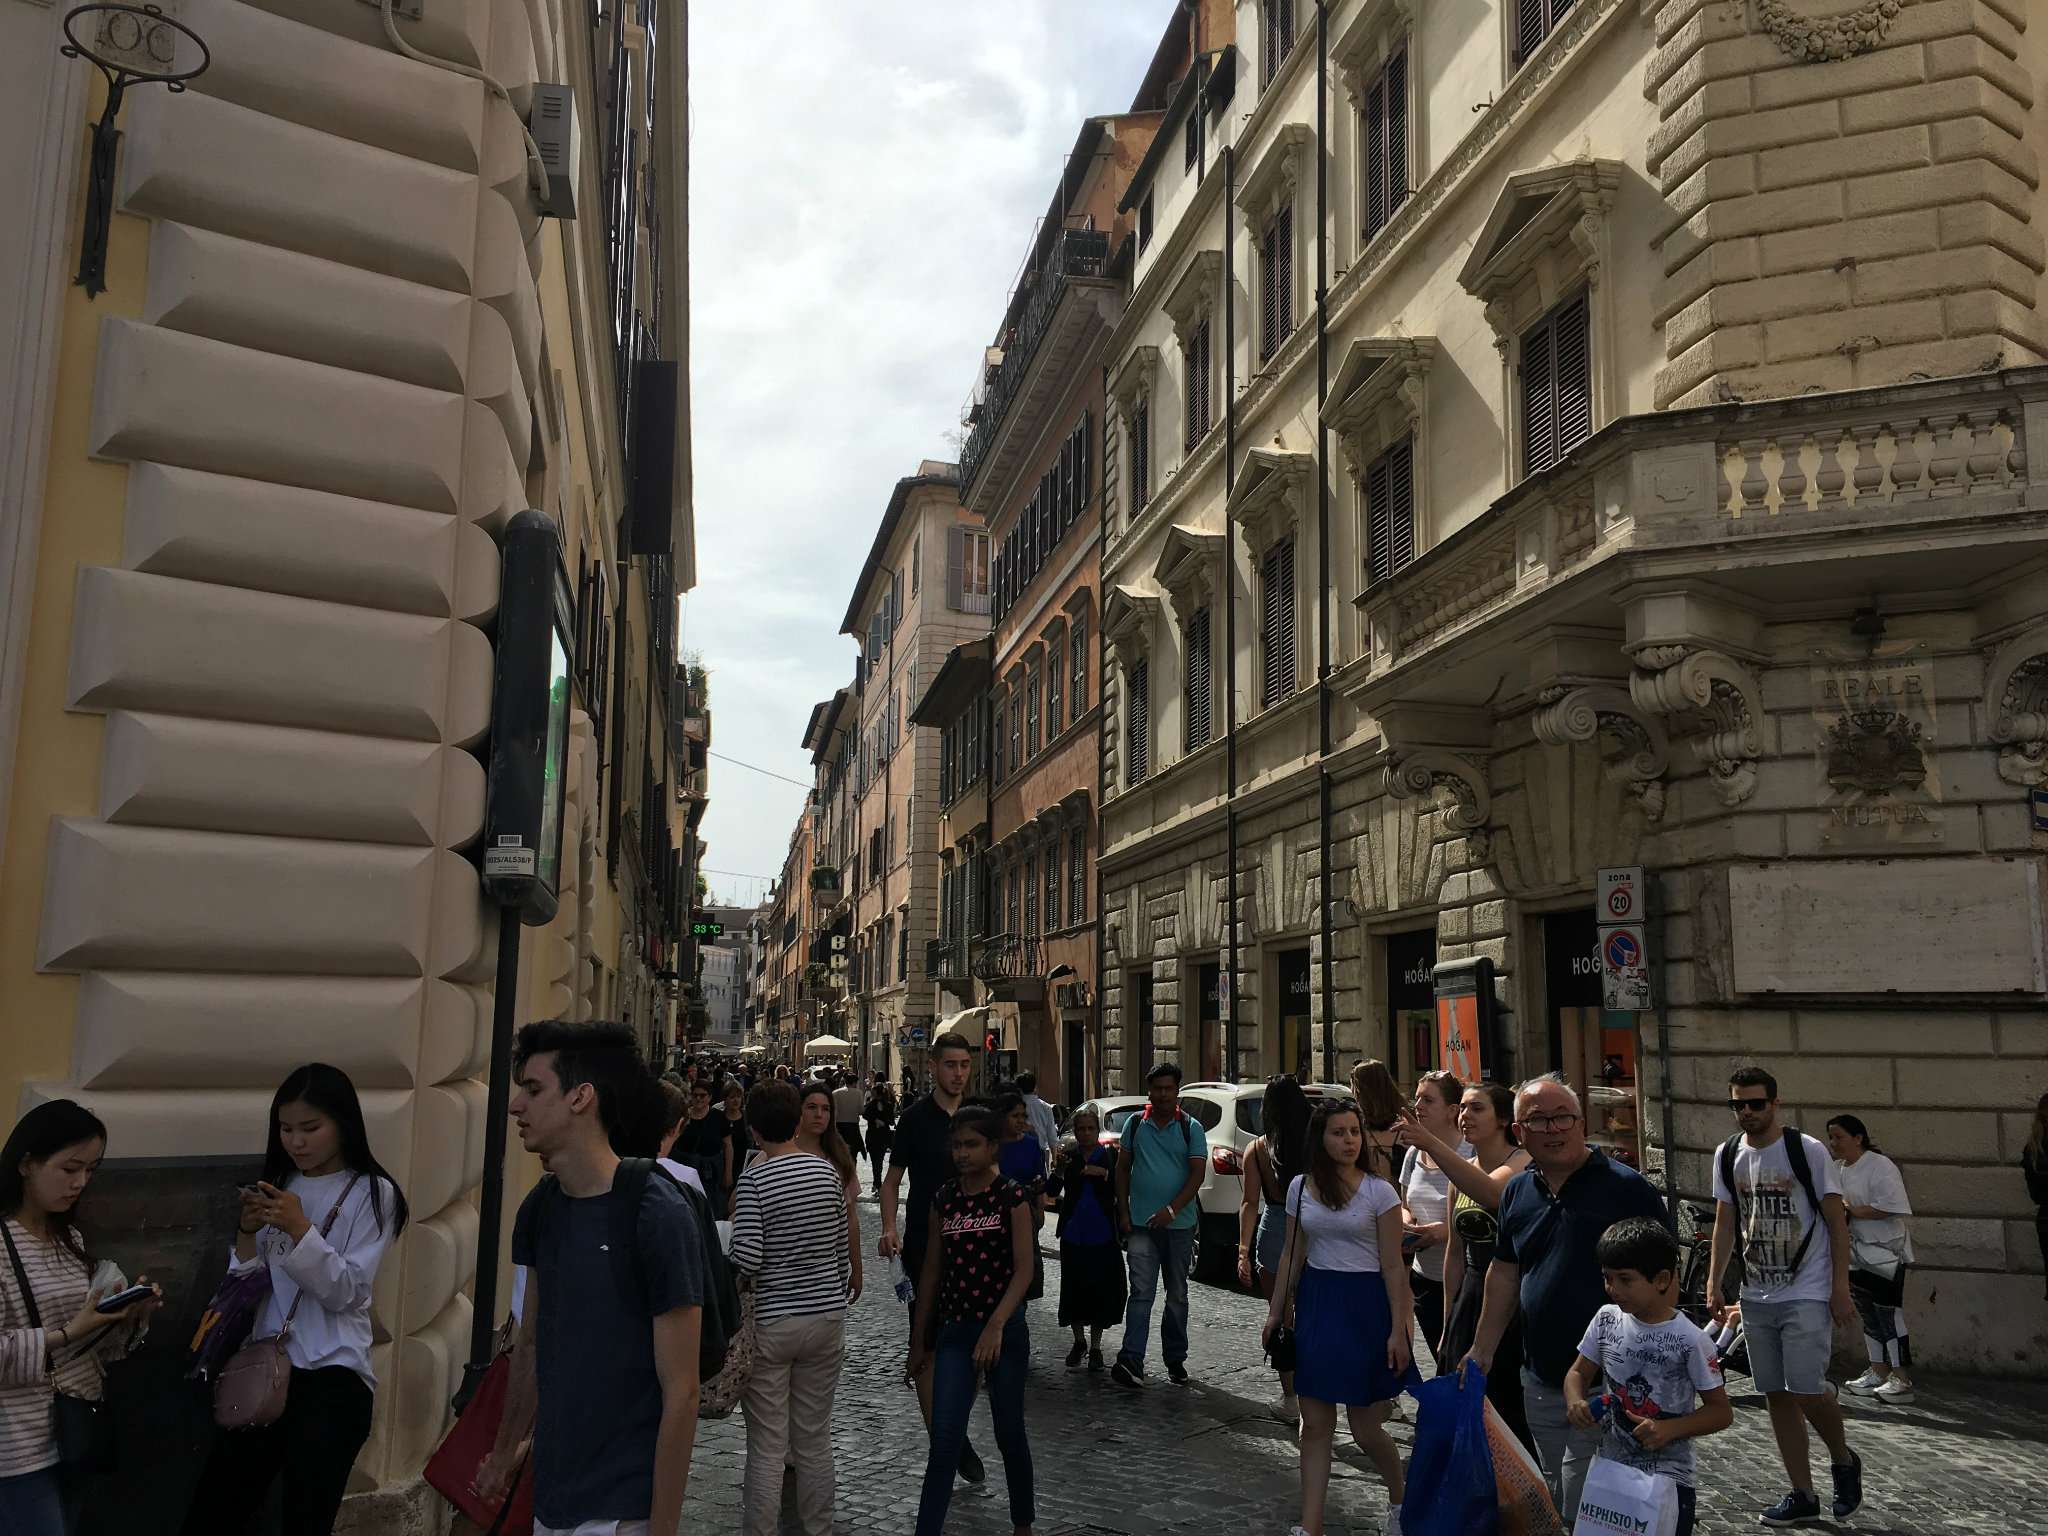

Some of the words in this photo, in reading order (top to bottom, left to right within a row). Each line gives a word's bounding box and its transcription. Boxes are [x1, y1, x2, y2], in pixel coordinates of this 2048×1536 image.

[1824, 675, 1922, 699] REALE
[1831, 805, 1929, 828] MUTUA
[1608, 873, 1631, 882] zona
[1613, 896, 1627, 909] 20
[693, 924, 707, 934] 33
[1446, 1039, 1471, 1052] HOGAN
[1635, 1331, 1687, 1344] SUNSHINE
[1580, 1501, 1632, 1529] MEPHISTO
